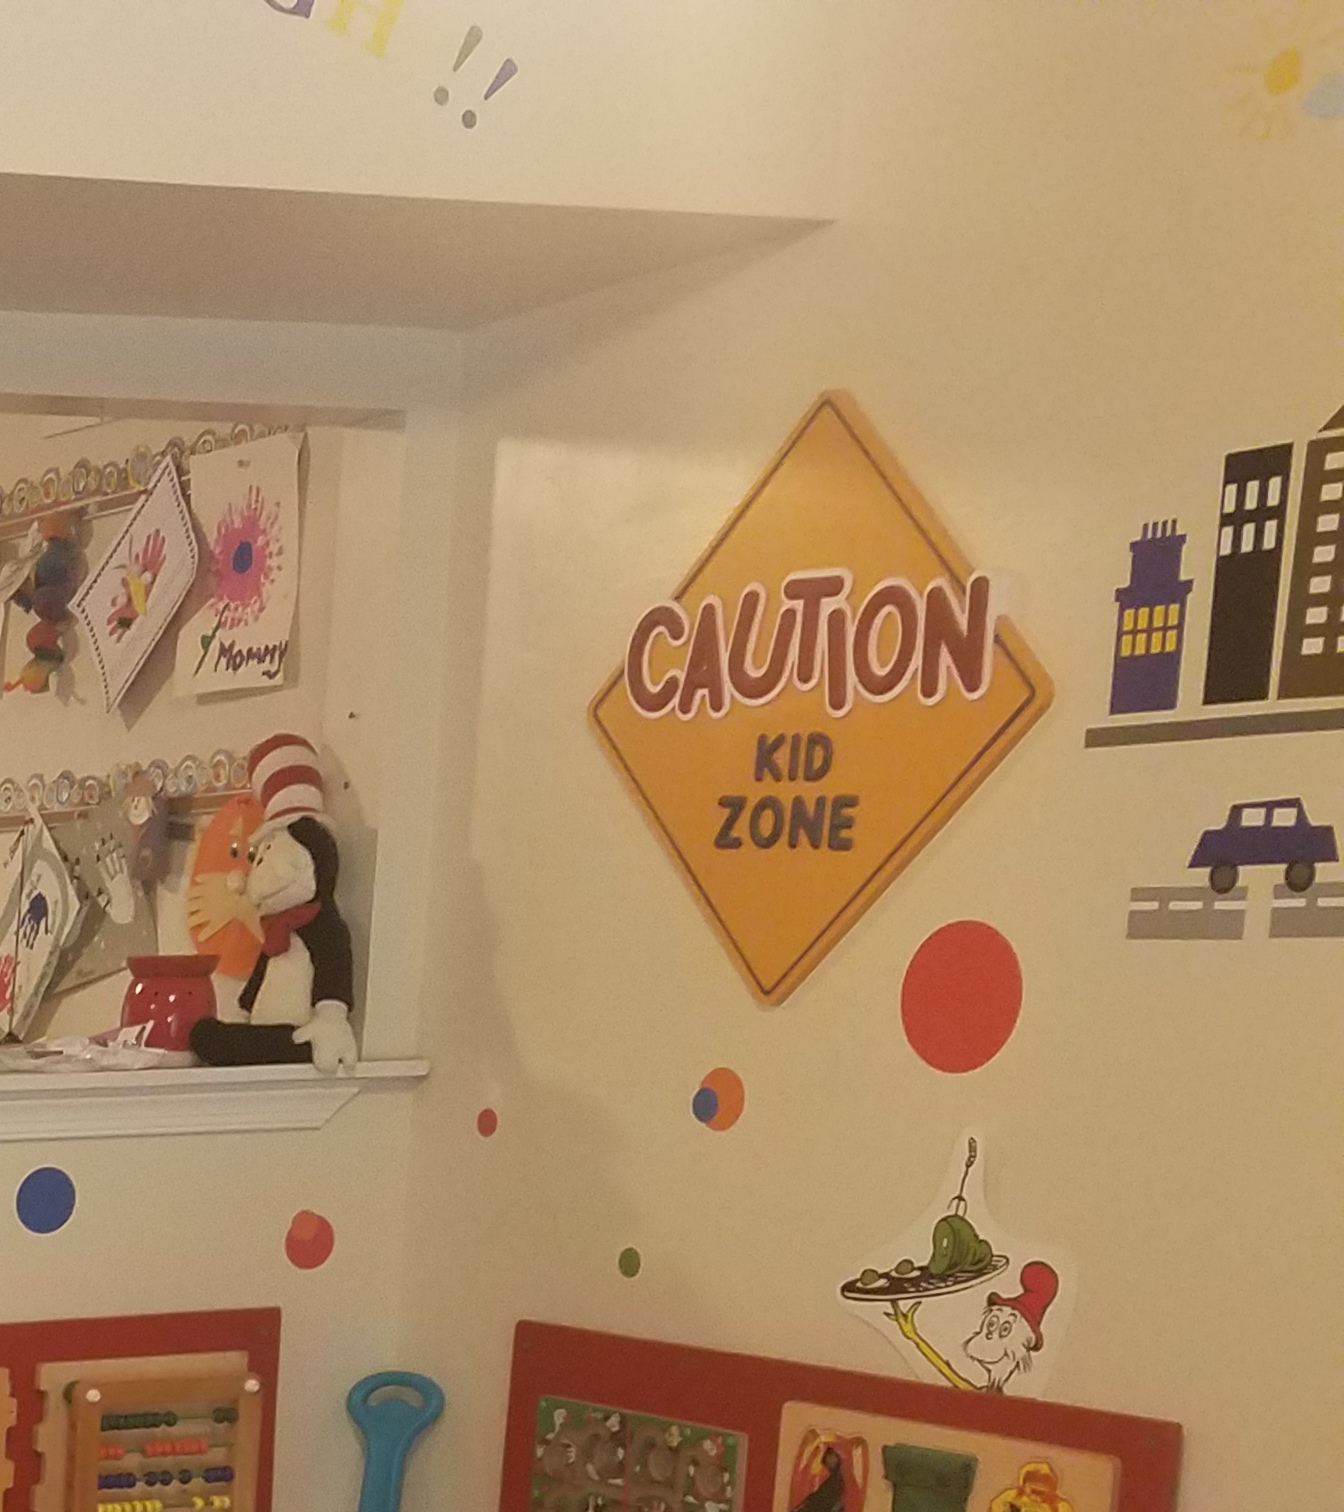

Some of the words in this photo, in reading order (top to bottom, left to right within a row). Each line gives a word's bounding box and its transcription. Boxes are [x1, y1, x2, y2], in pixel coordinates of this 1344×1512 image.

[214, 638, 289, 681] Mommy
[624, 570, 994, 718] CAUTION
[753, 731, 835, 784] KID
[712, 794, 861, 853] ZONE
